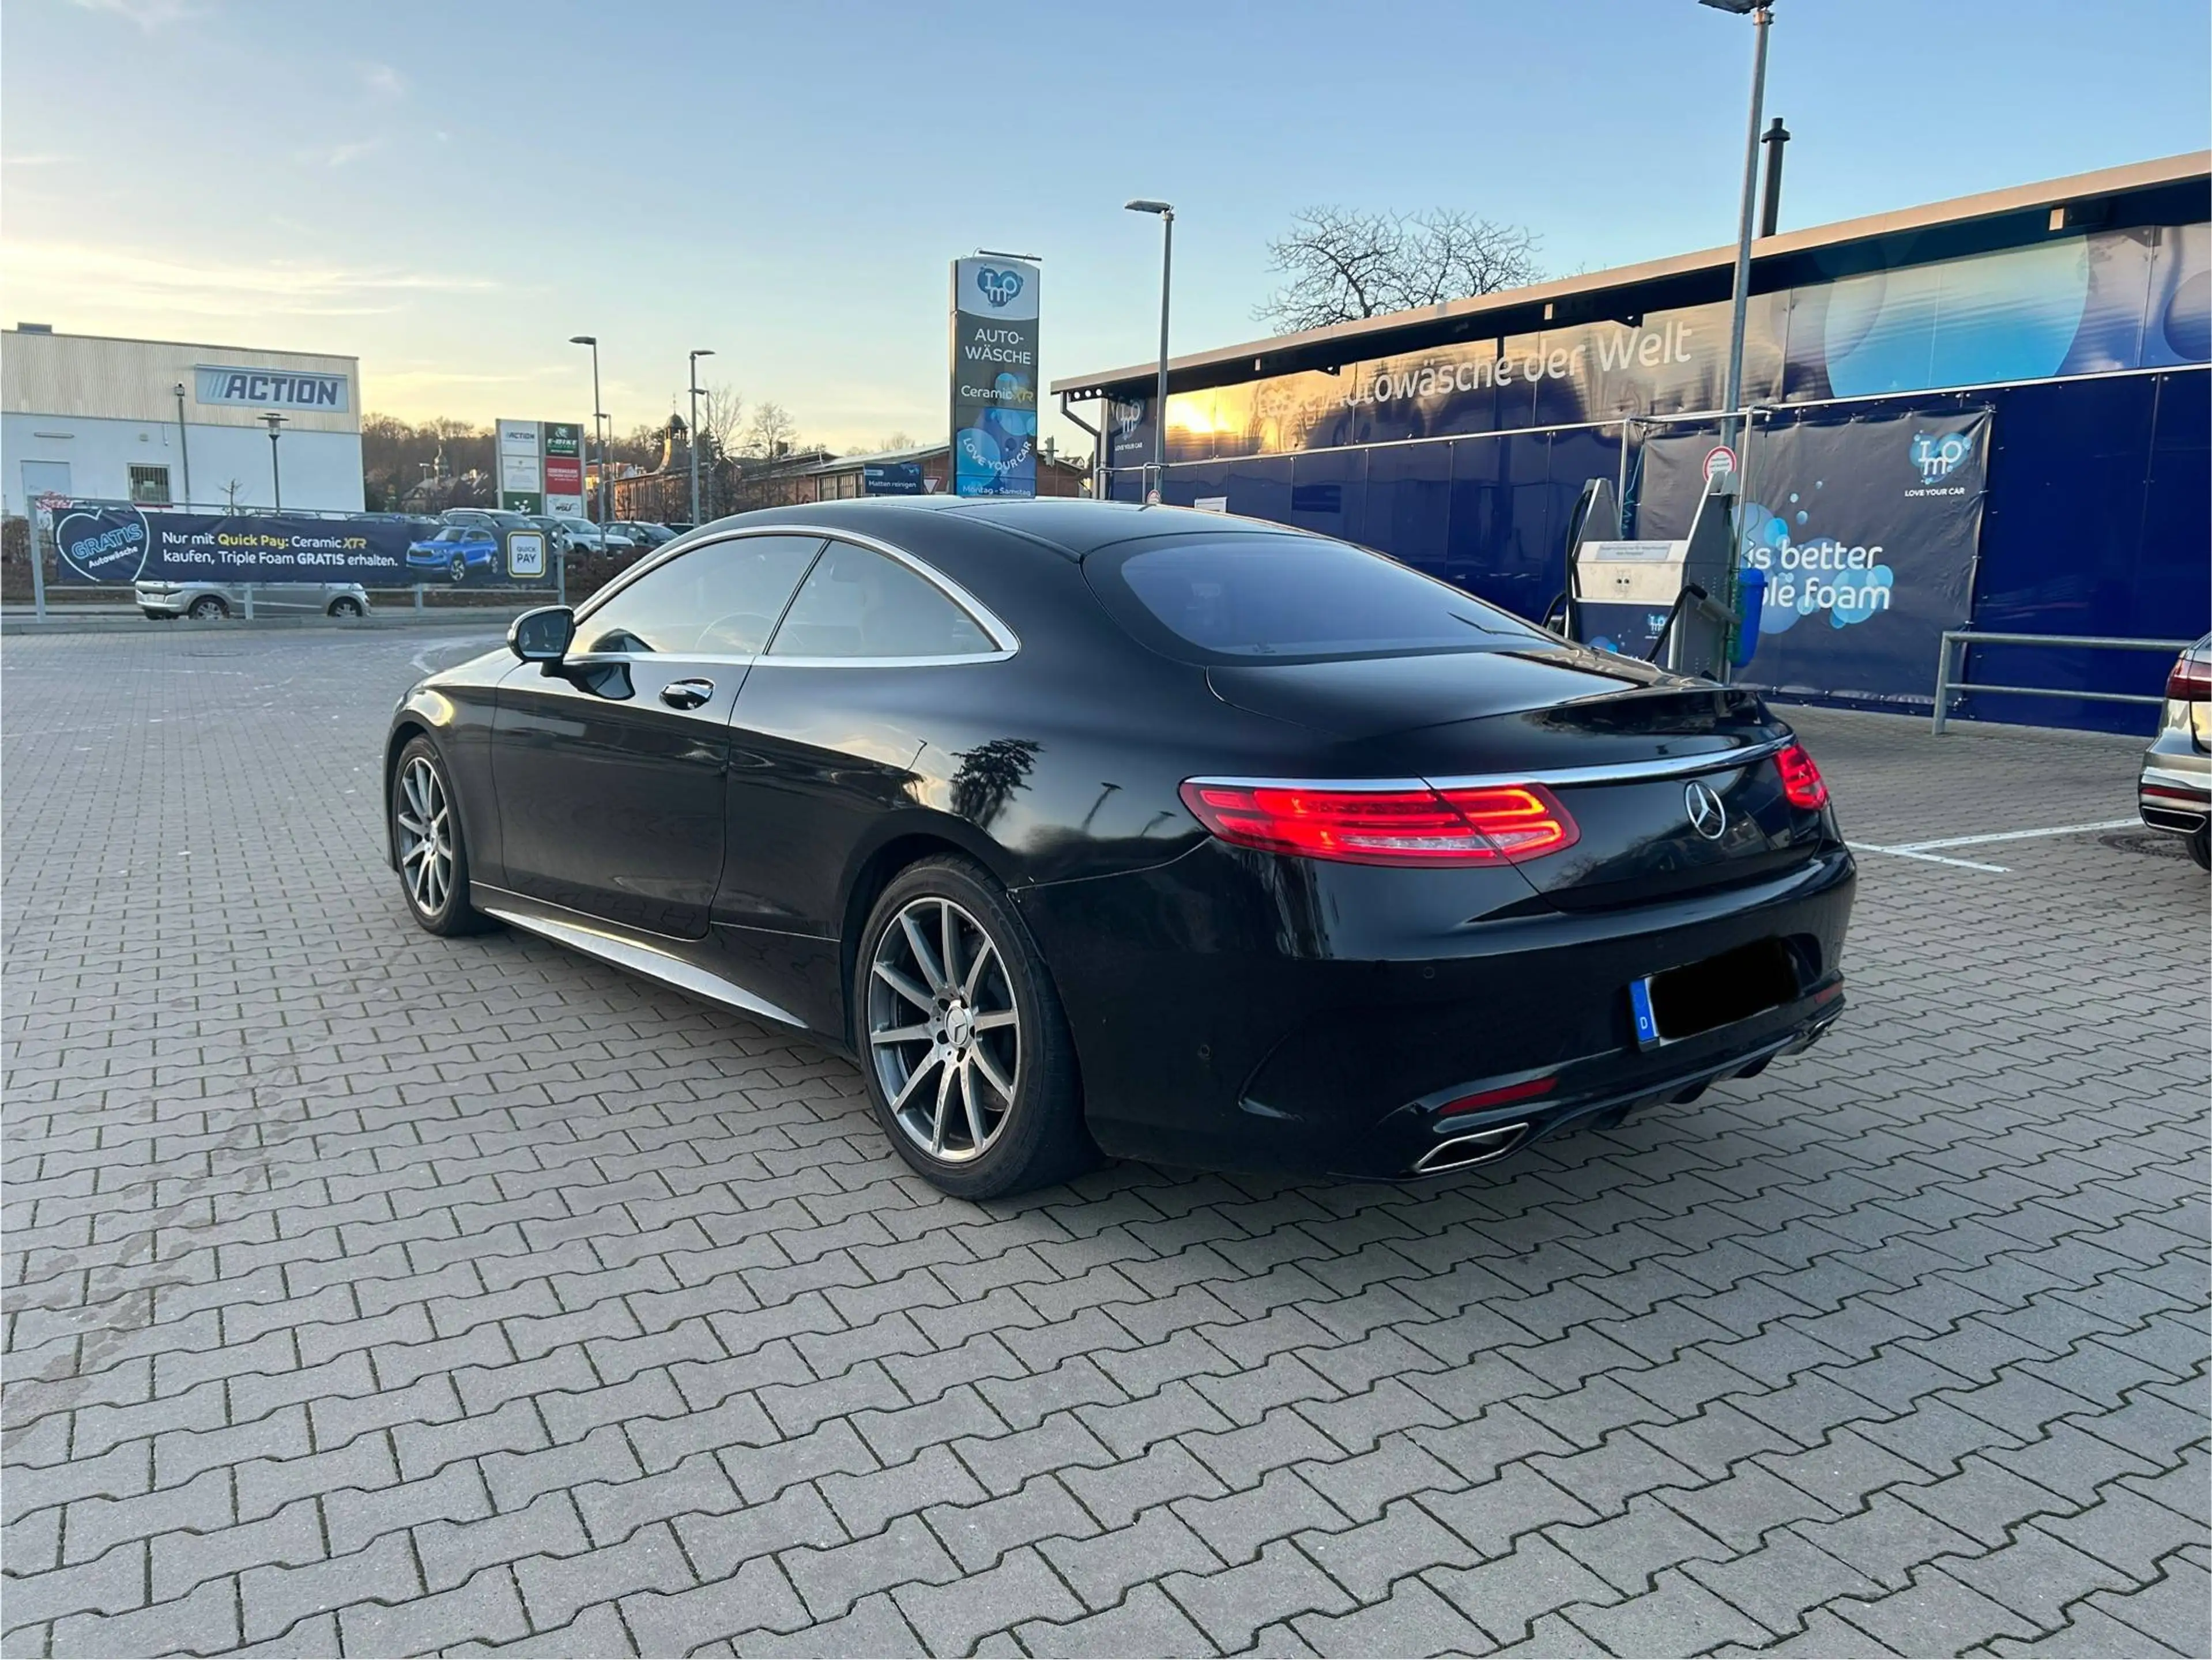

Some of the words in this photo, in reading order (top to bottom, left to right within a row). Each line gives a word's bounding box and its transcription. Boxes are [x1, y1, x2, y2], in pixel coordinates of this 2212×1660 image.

[975, 328, 1024, 345] AUTO-
[965, 344, 1031, 365] WÄSCHE
[1524, 338, 1586, 382] der
[1596, 321, 1693, 371] Welt
[224, 375, 337, 405] ACTION
[963, 437, 986, 466] LOVE
[988, 458, 1018, 470] YOUR
[1016, 441, 1032, 462] CAR
[892, 480, 917, 489] reinigen
[963, 485, 994, 495] Montag
[1000, 488, 1031, 496] Samstag
[1905, 489, 1924, 497] LOVE
[71, 523, 143, 560] GRATIS
[162, 532, 188, 544] Nur
[192, 533, 215, 545] mit
[218, 533, 258, 546] Quick
[261, 535, 289, 549] Pay:
[89, 546, 138, 568] Autowäsche
[163, 549, 215, 565] kaufen,
[218, 551, 256, 566] Triple
[259, 552, 294, 564] Foam
[297, 553, 345, 565] GRATIS
[348, 554, 398, 567] erhalten.
[517, 553, 536, 563] PAY
[1748, 541, 1771, 569] is
[1781, 539, 1883, 570] better
[1804, 577, 1890, 610] foam
[1640, 1016, 1648, 1029] D
